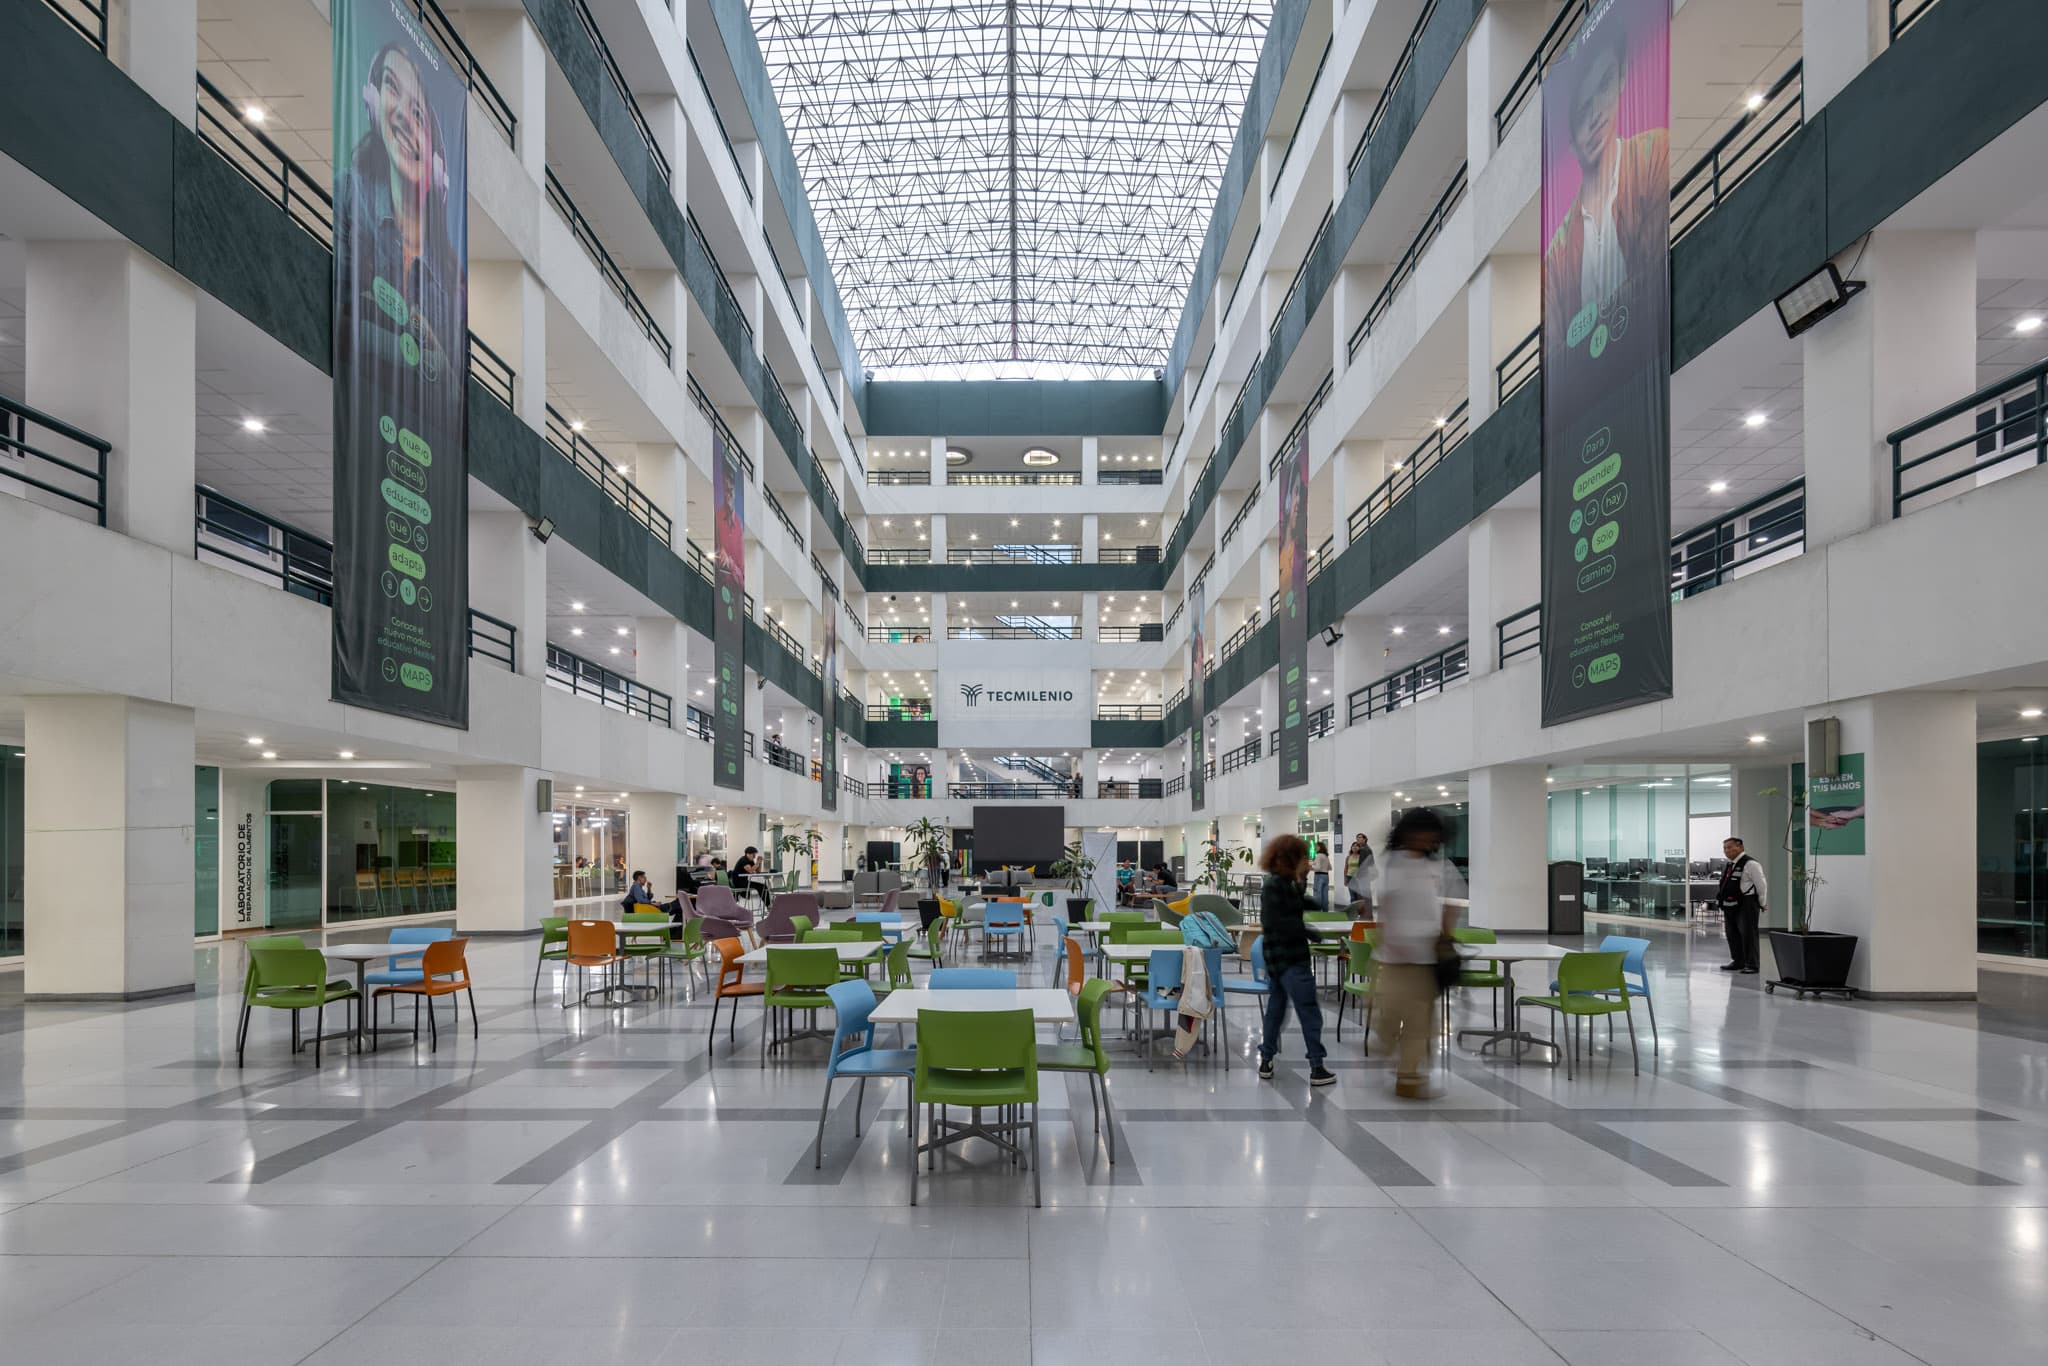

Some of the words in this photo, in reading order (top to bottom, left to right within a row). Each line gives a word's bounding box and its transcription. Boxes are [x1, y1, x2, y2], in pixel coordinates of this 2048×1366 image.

[390, 1, 439, 71] TECMILENIO
[391, 459, 424, 487] modelo
[1577, 462, 1615, 493] aprender
[385, 487, 429, 517] educativo
[389, 519, 407, 536] que
[392, 551, 422, 572] adapta
[1580, 563, 1612, 585] camino
[402, 666, 431, 686] MAPS
[1590, 658, 1618, 677] MAPS
[987, 691, 1073, 702] TECMILENIO
[1812, 783, 1829, 793] TUS
[1830, 781, 1861, 792] MANOS
[1841, 773, 1854, 782] EN
[238, 824, 246, 839] DE
[247, 857, 252, 867] DE
[238, 842, 246, 922] LABORATORIO
